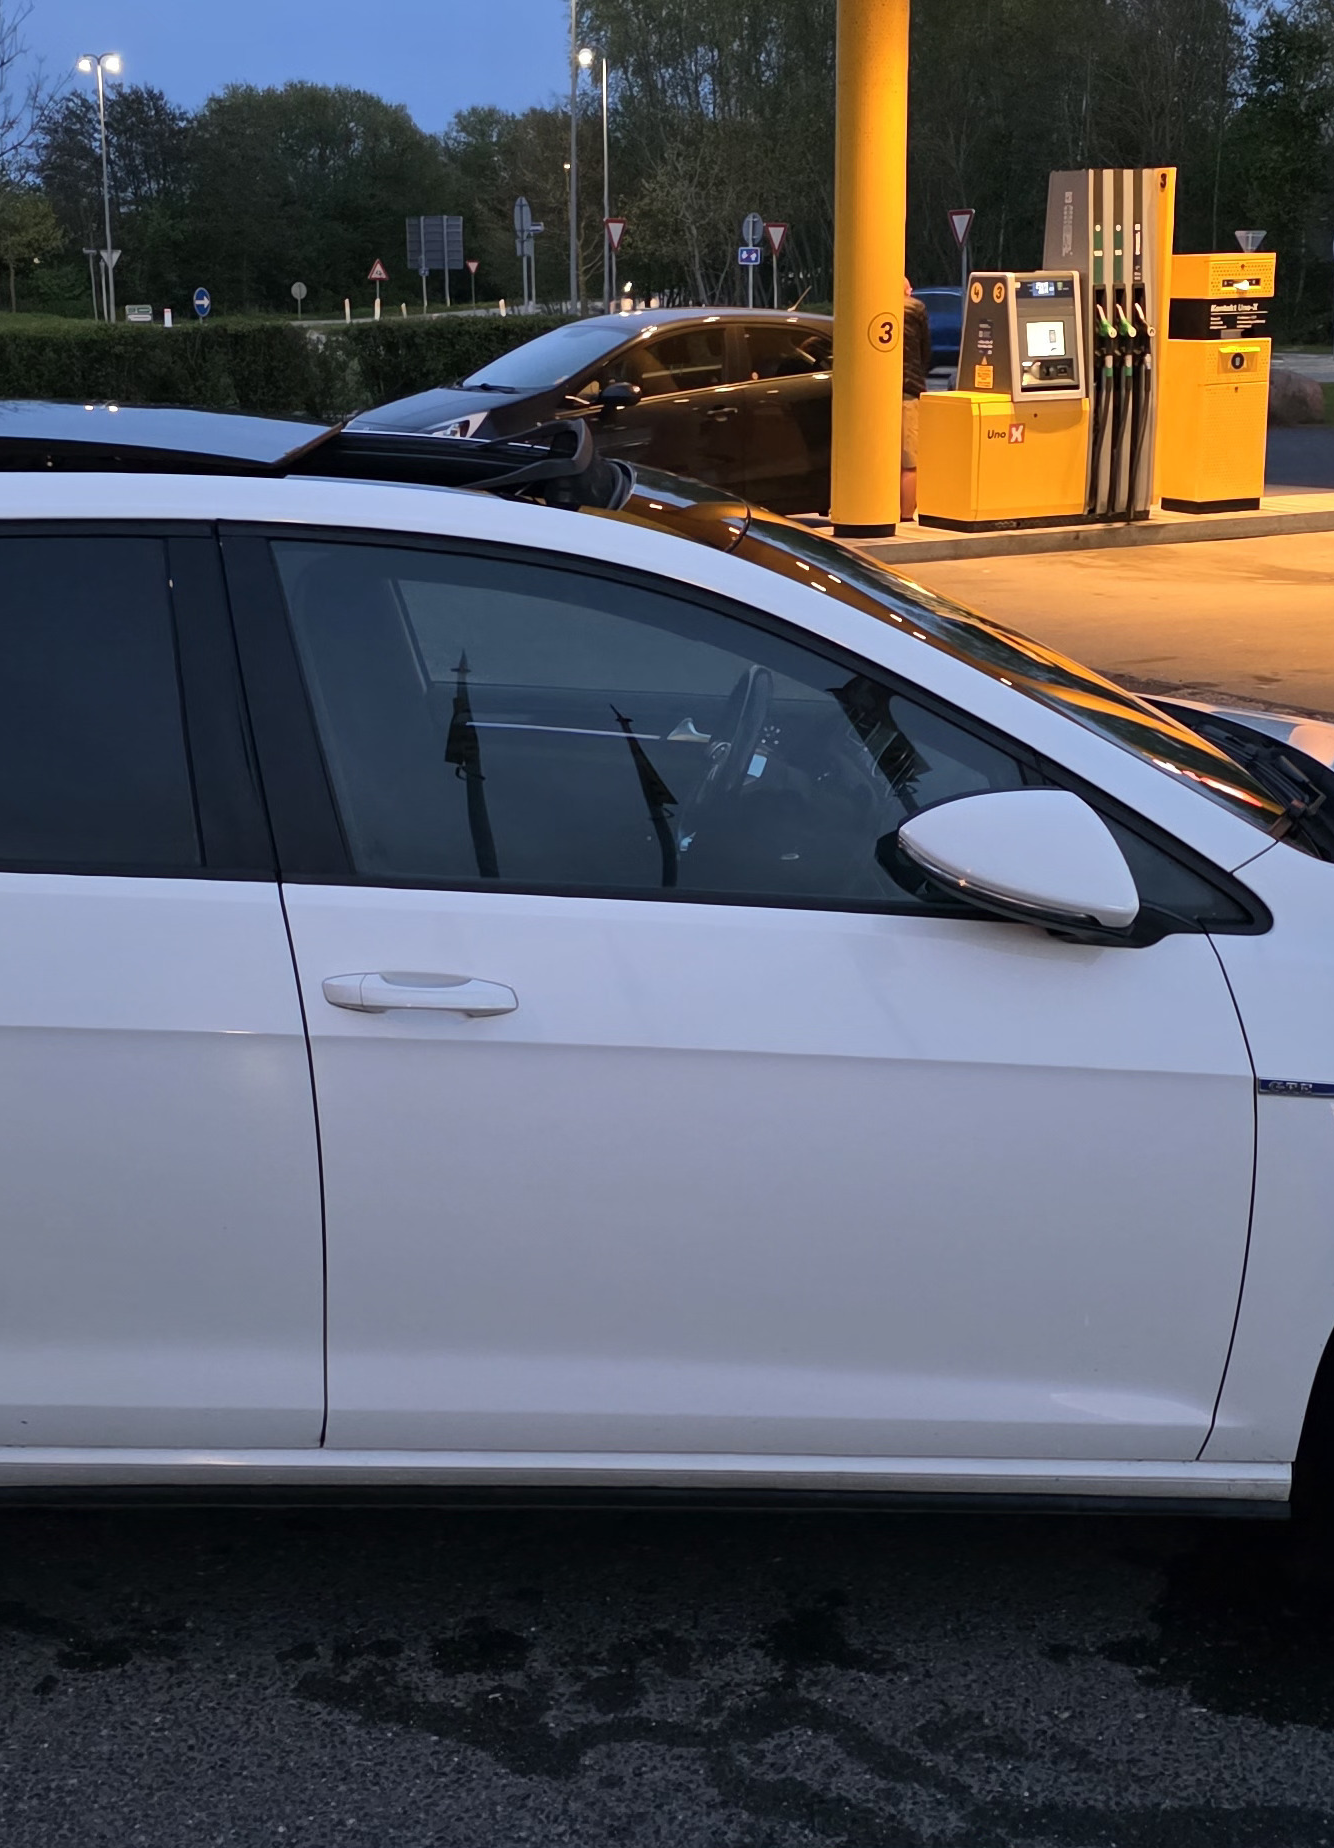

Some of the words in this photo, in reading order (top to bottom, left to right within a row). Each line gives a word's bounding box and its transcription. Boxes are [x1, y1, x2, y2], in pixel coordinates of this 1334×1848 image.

[1159, 173, 1167, 189] 3
[995, 286, 1003, 300] 3
[878, 321, 893, 344] 3
[987, 429, 1007, 439] Uno
